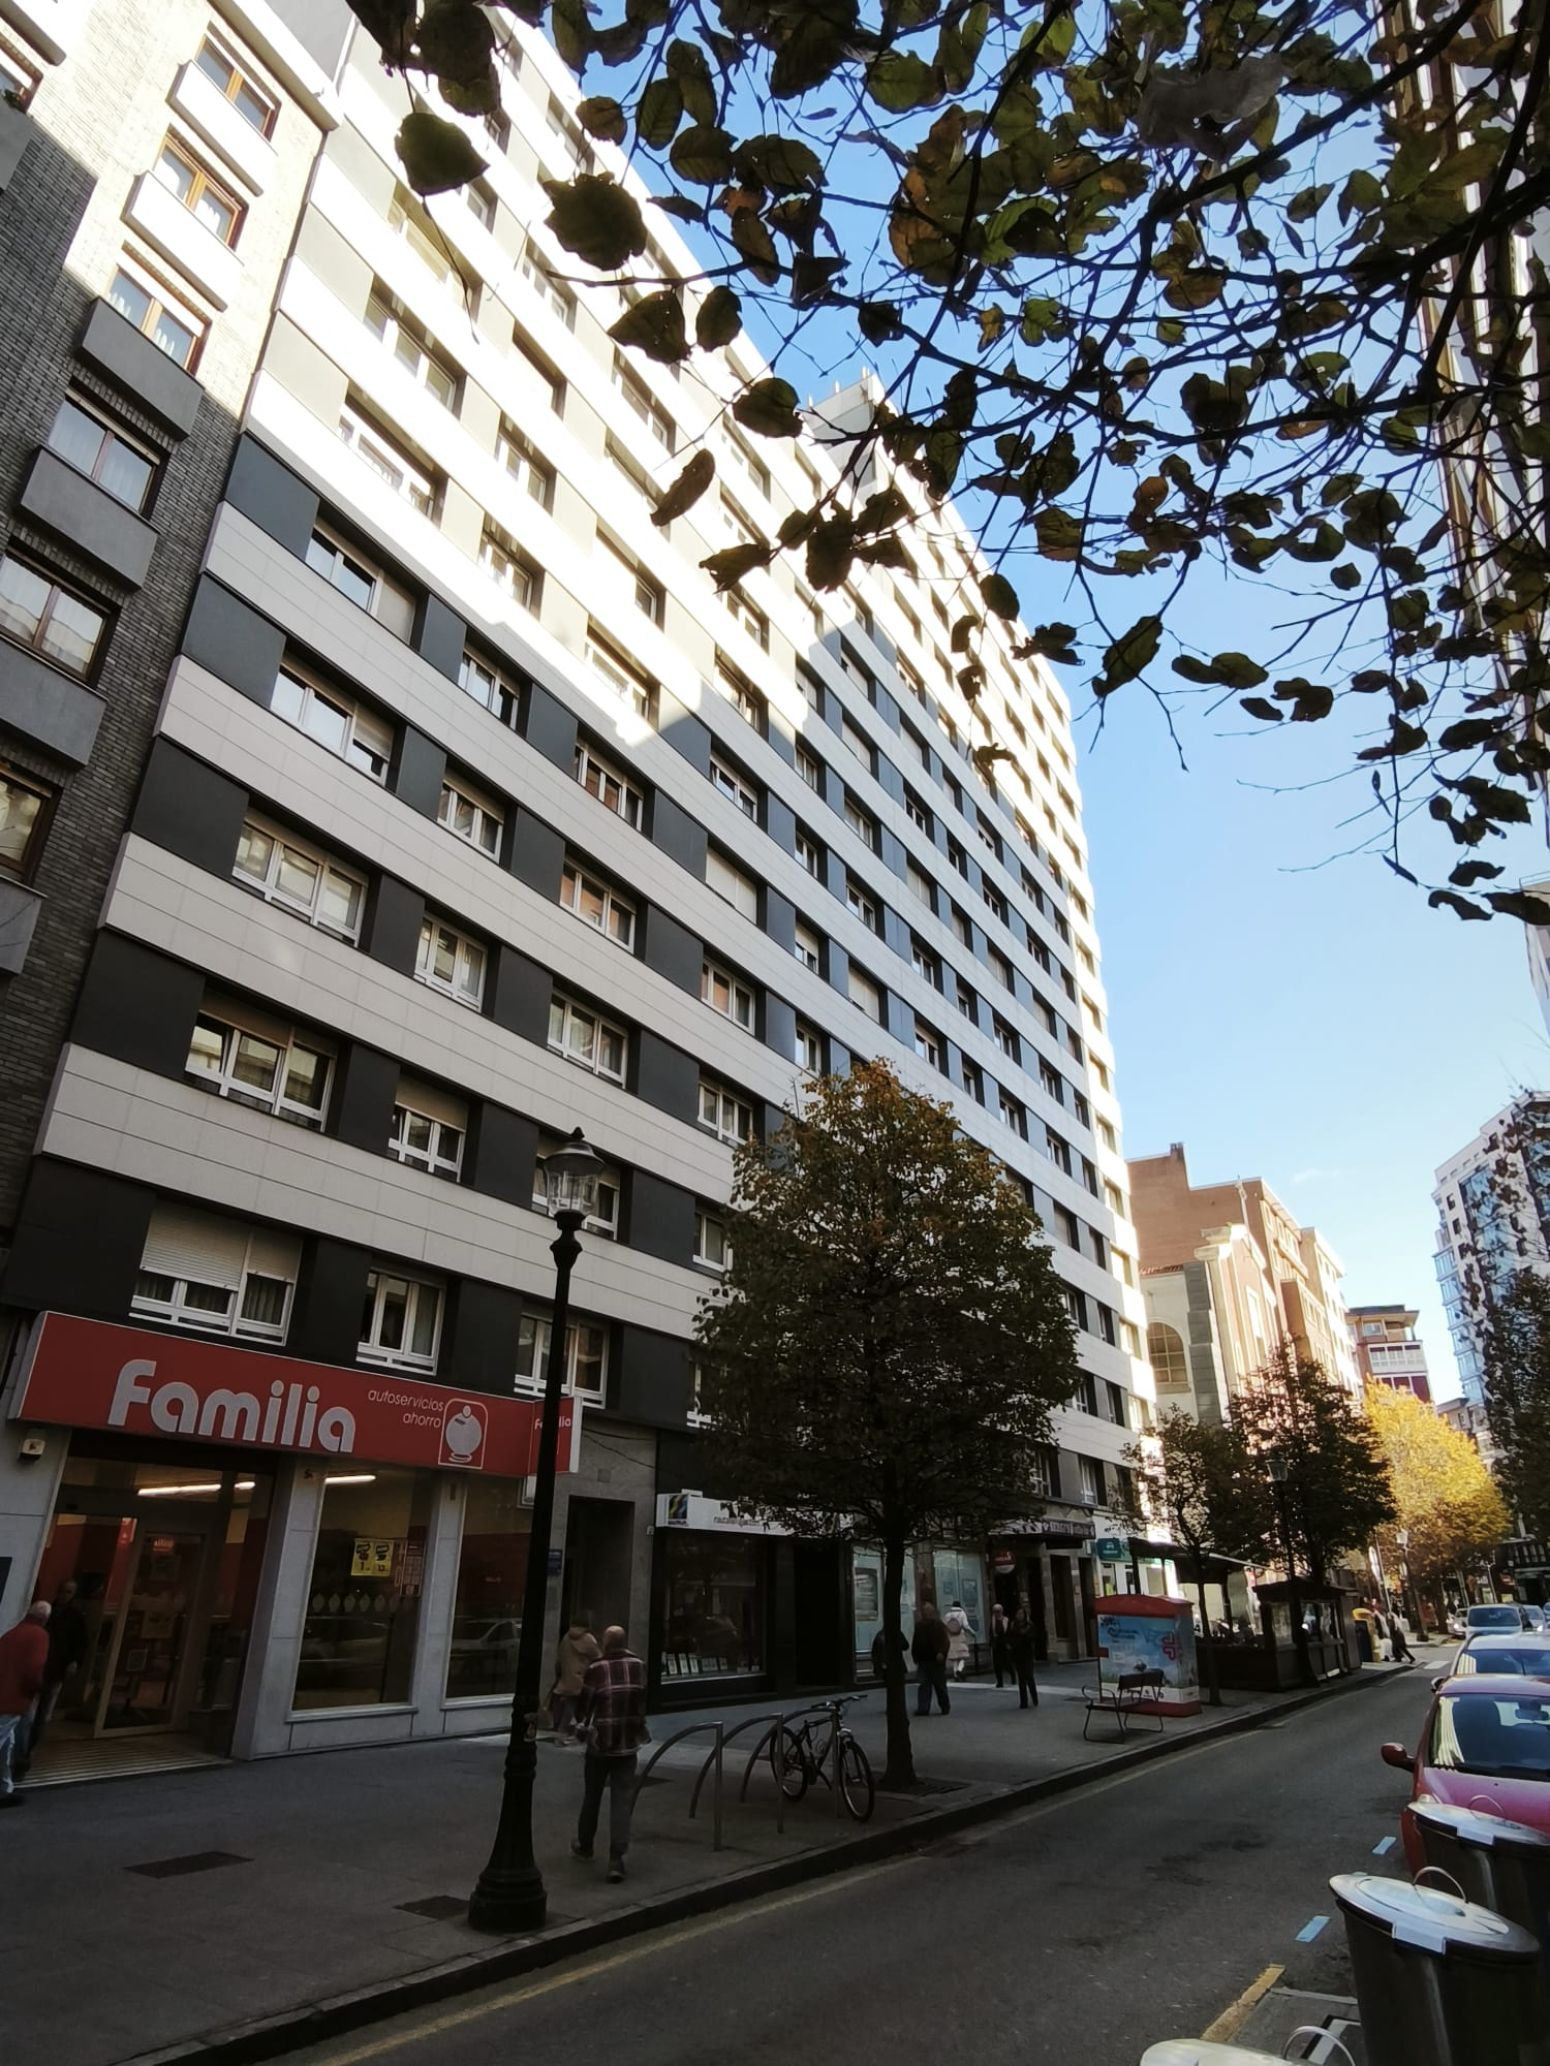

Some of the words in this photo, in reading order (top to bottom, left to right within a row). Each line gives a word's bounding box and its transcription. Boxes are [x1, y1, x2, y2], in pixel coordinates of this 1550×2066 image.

[107, 1358, 357, 1453] Familia
[367, 1389, 445, 1412] autoservicios
[402, 1411, 441, 1428] ahorro
[534, 1415, 572, 1430] Flia
